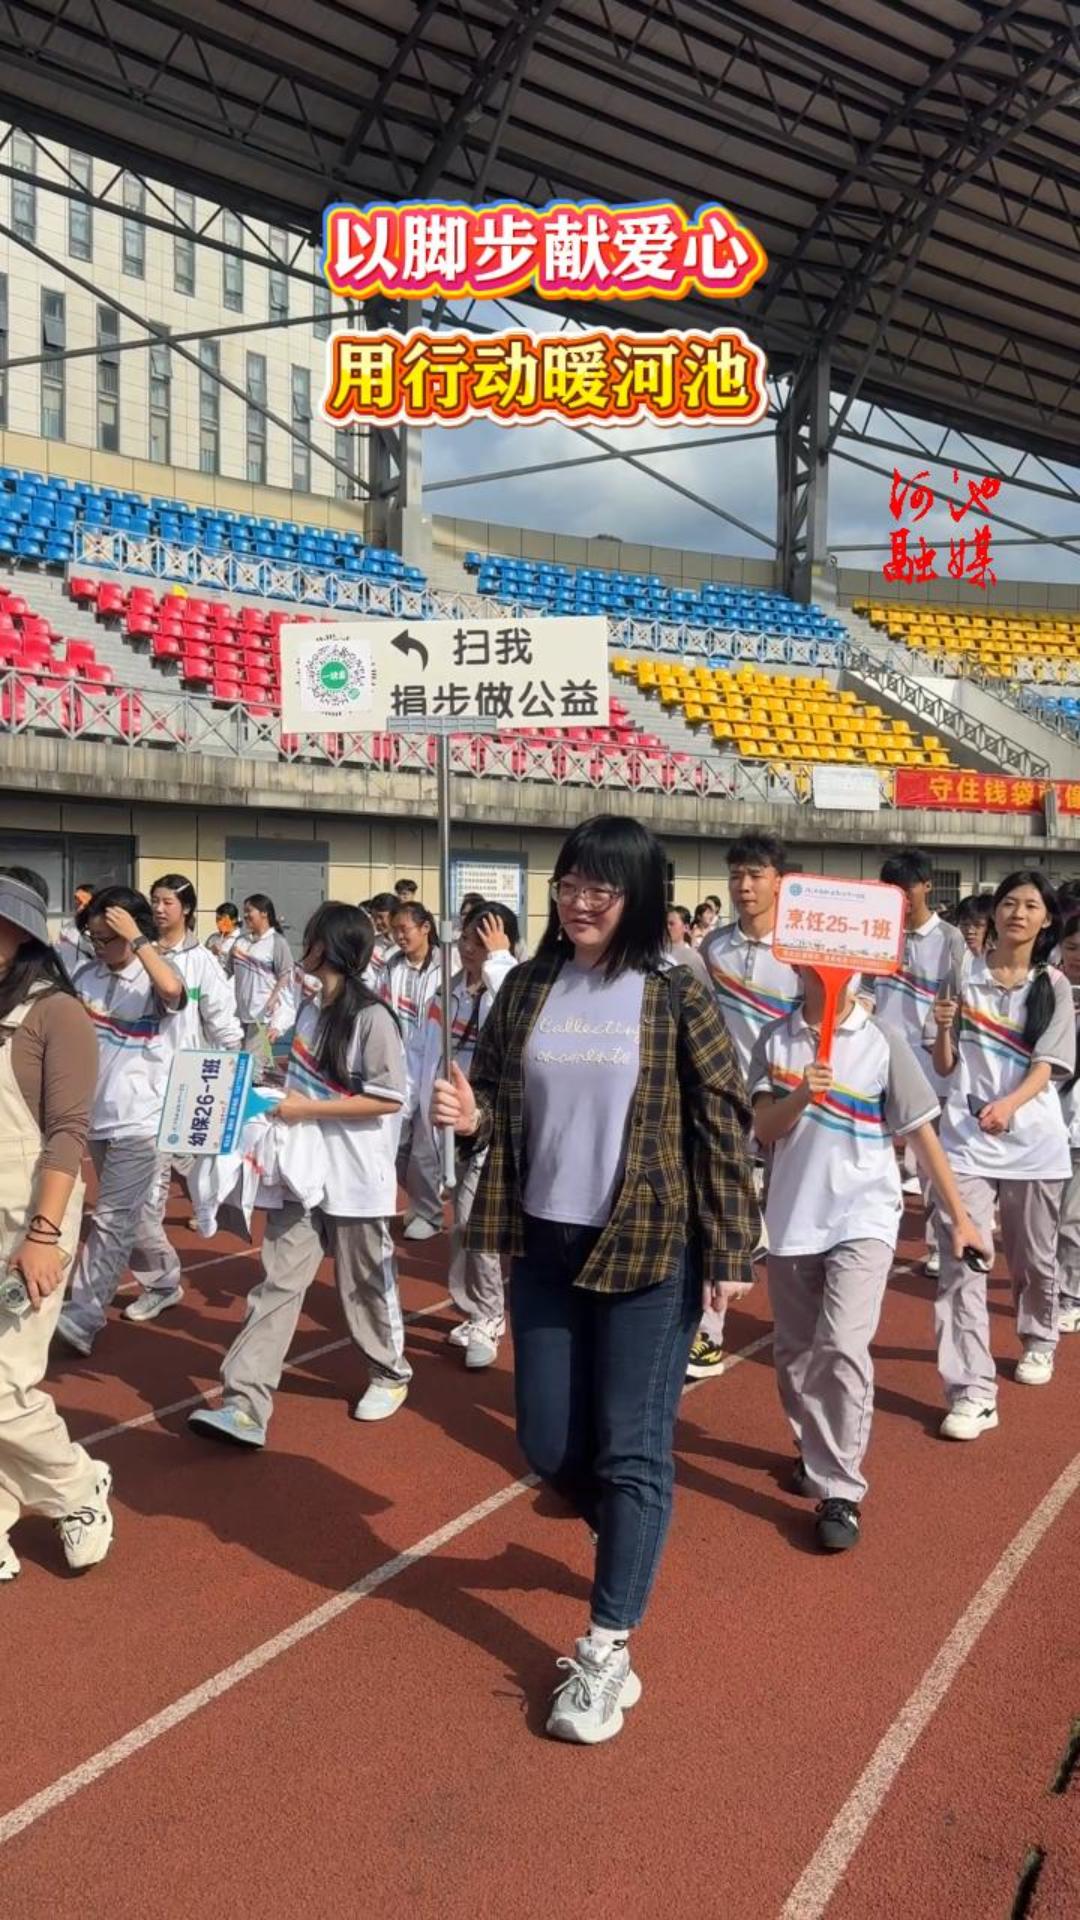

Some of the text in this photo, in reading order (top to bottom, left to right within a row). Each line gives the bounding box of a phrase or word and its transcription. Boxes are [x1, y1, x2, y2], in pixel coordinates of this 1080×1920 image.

[452, 626, 533, 667] 扫我
[390, 679, 599, 719] 捐步做公益
[785, 907, 892, 940] 烹饪25-1班
[187, 1058, 221, 1146] 幼保26-1班
